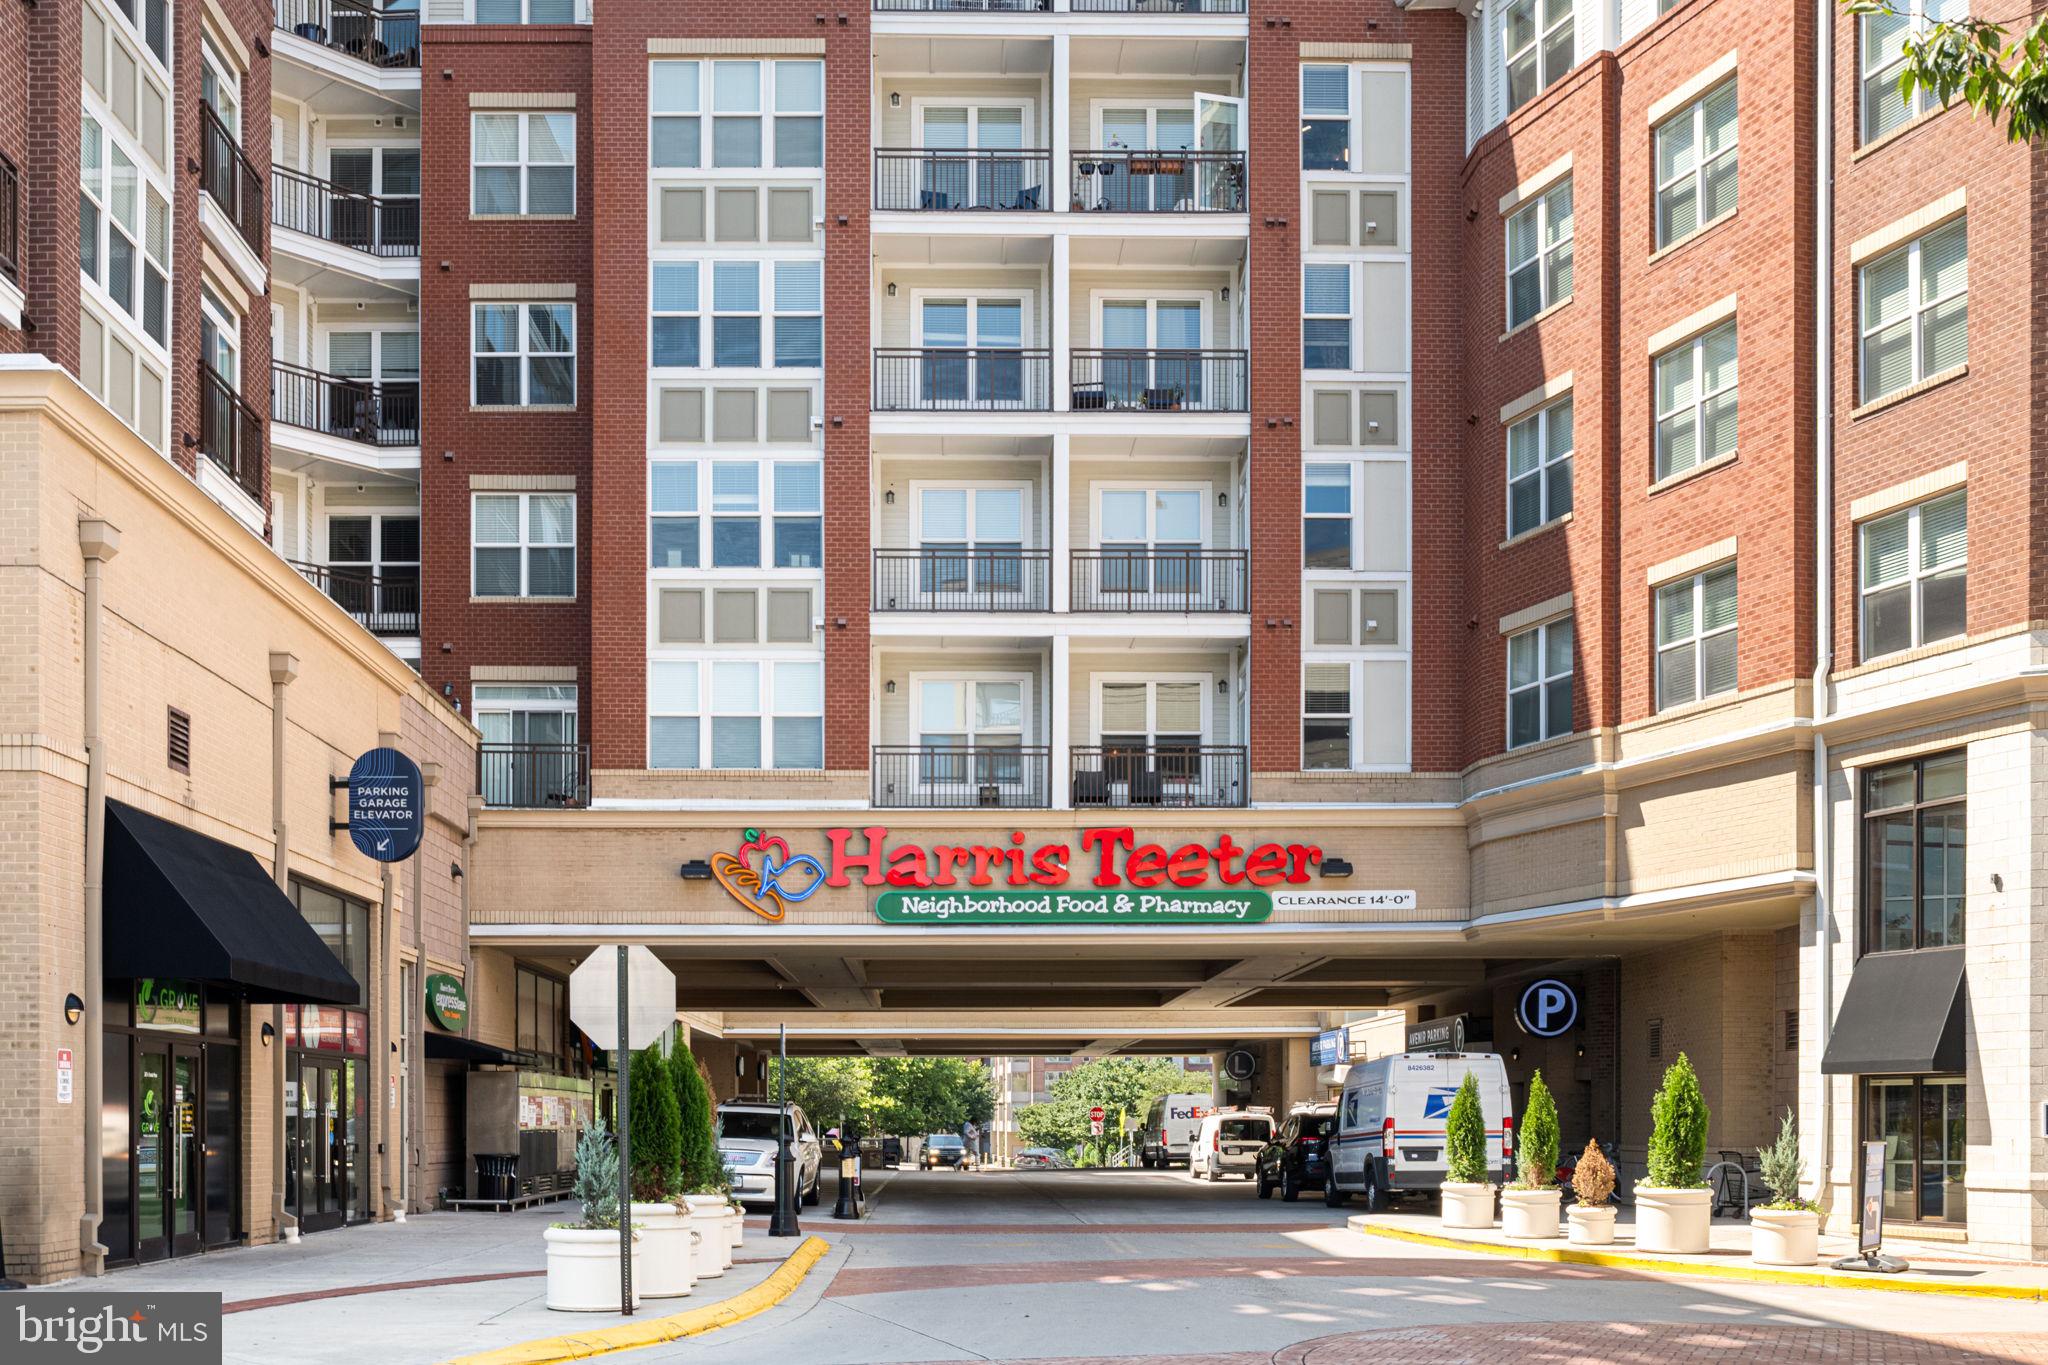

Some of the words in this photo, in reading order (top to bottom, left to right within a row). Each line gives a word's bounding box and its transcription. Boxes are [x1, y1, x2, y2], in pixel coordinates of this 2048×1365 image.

[357, 787, 409, 796] PARKING
[359, 799, 408, 808] GARAGE
[353, 810, 413, 819] ELEVATOR
[824, 826, 1070, 888] Harris
[1082, 826, 1323, 888] Teeter
[901, 896, 1052, 919] Neighborhood
[1056, 896, 1108, 914] Food
[1113, 894, 1134, 914] &
[1139, 896, 1251, 918] Pharmacy
[1278, 895, 1367, 906] CLEARANCE
[1538, 988, 1566, 1029] P
[1408, 1030, 1426, 1046] AVENIR
[1427, 1026, 1449, 1042] PARKING
[1234, 1055, 1247, 1074] L
